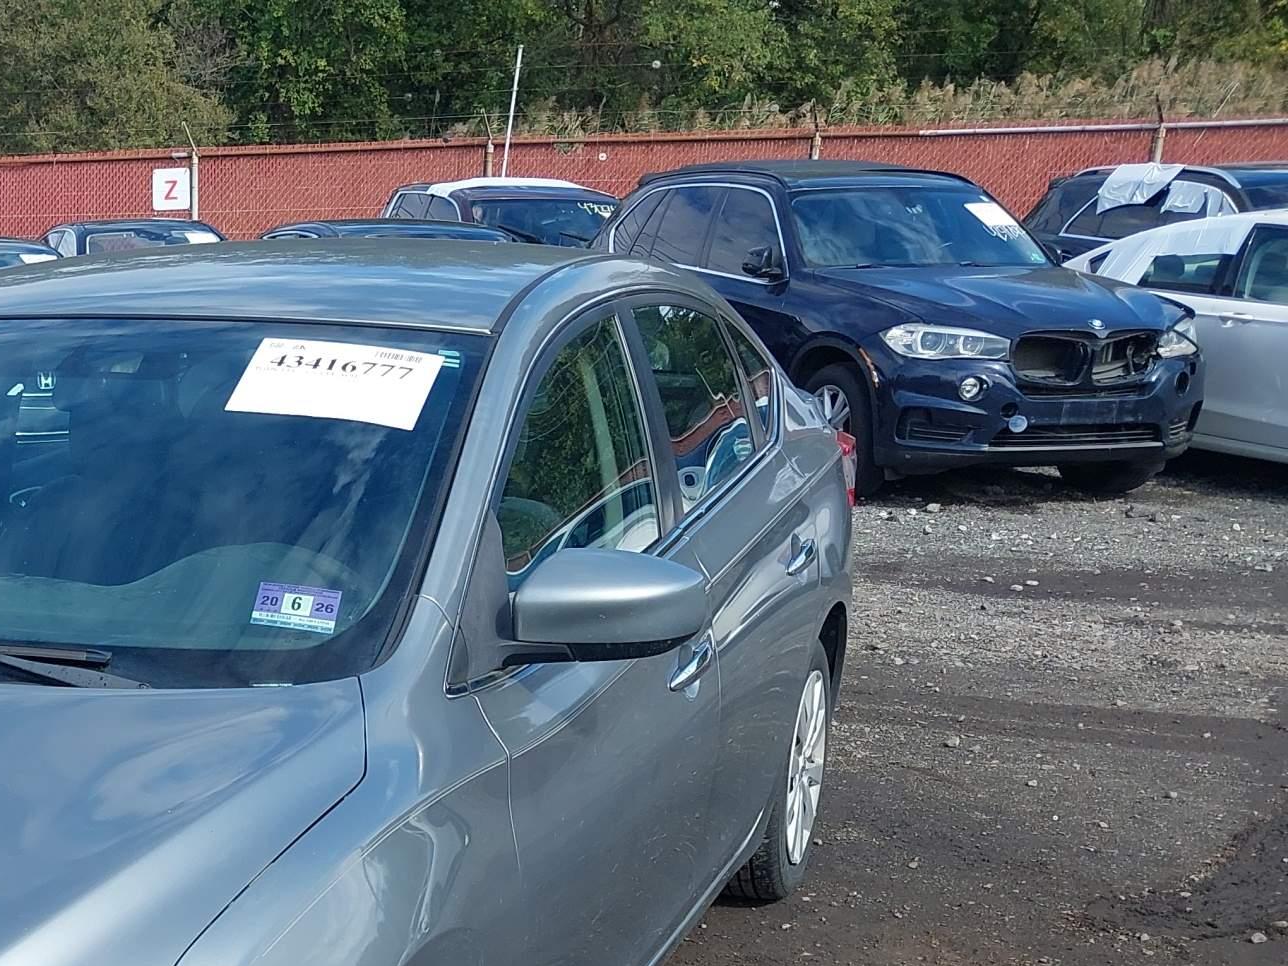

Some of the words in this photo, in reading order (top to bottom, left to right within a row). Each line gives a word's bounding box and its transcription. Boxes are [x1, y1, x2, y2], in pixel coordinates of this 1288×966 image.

[164, 180, 178, 200] Z
[270, 354, 414, 380] 43416777
[260, 595, 279, 607] 20
[291, 596, 302, 611] 6
[314, 602, 334, 614] 26
